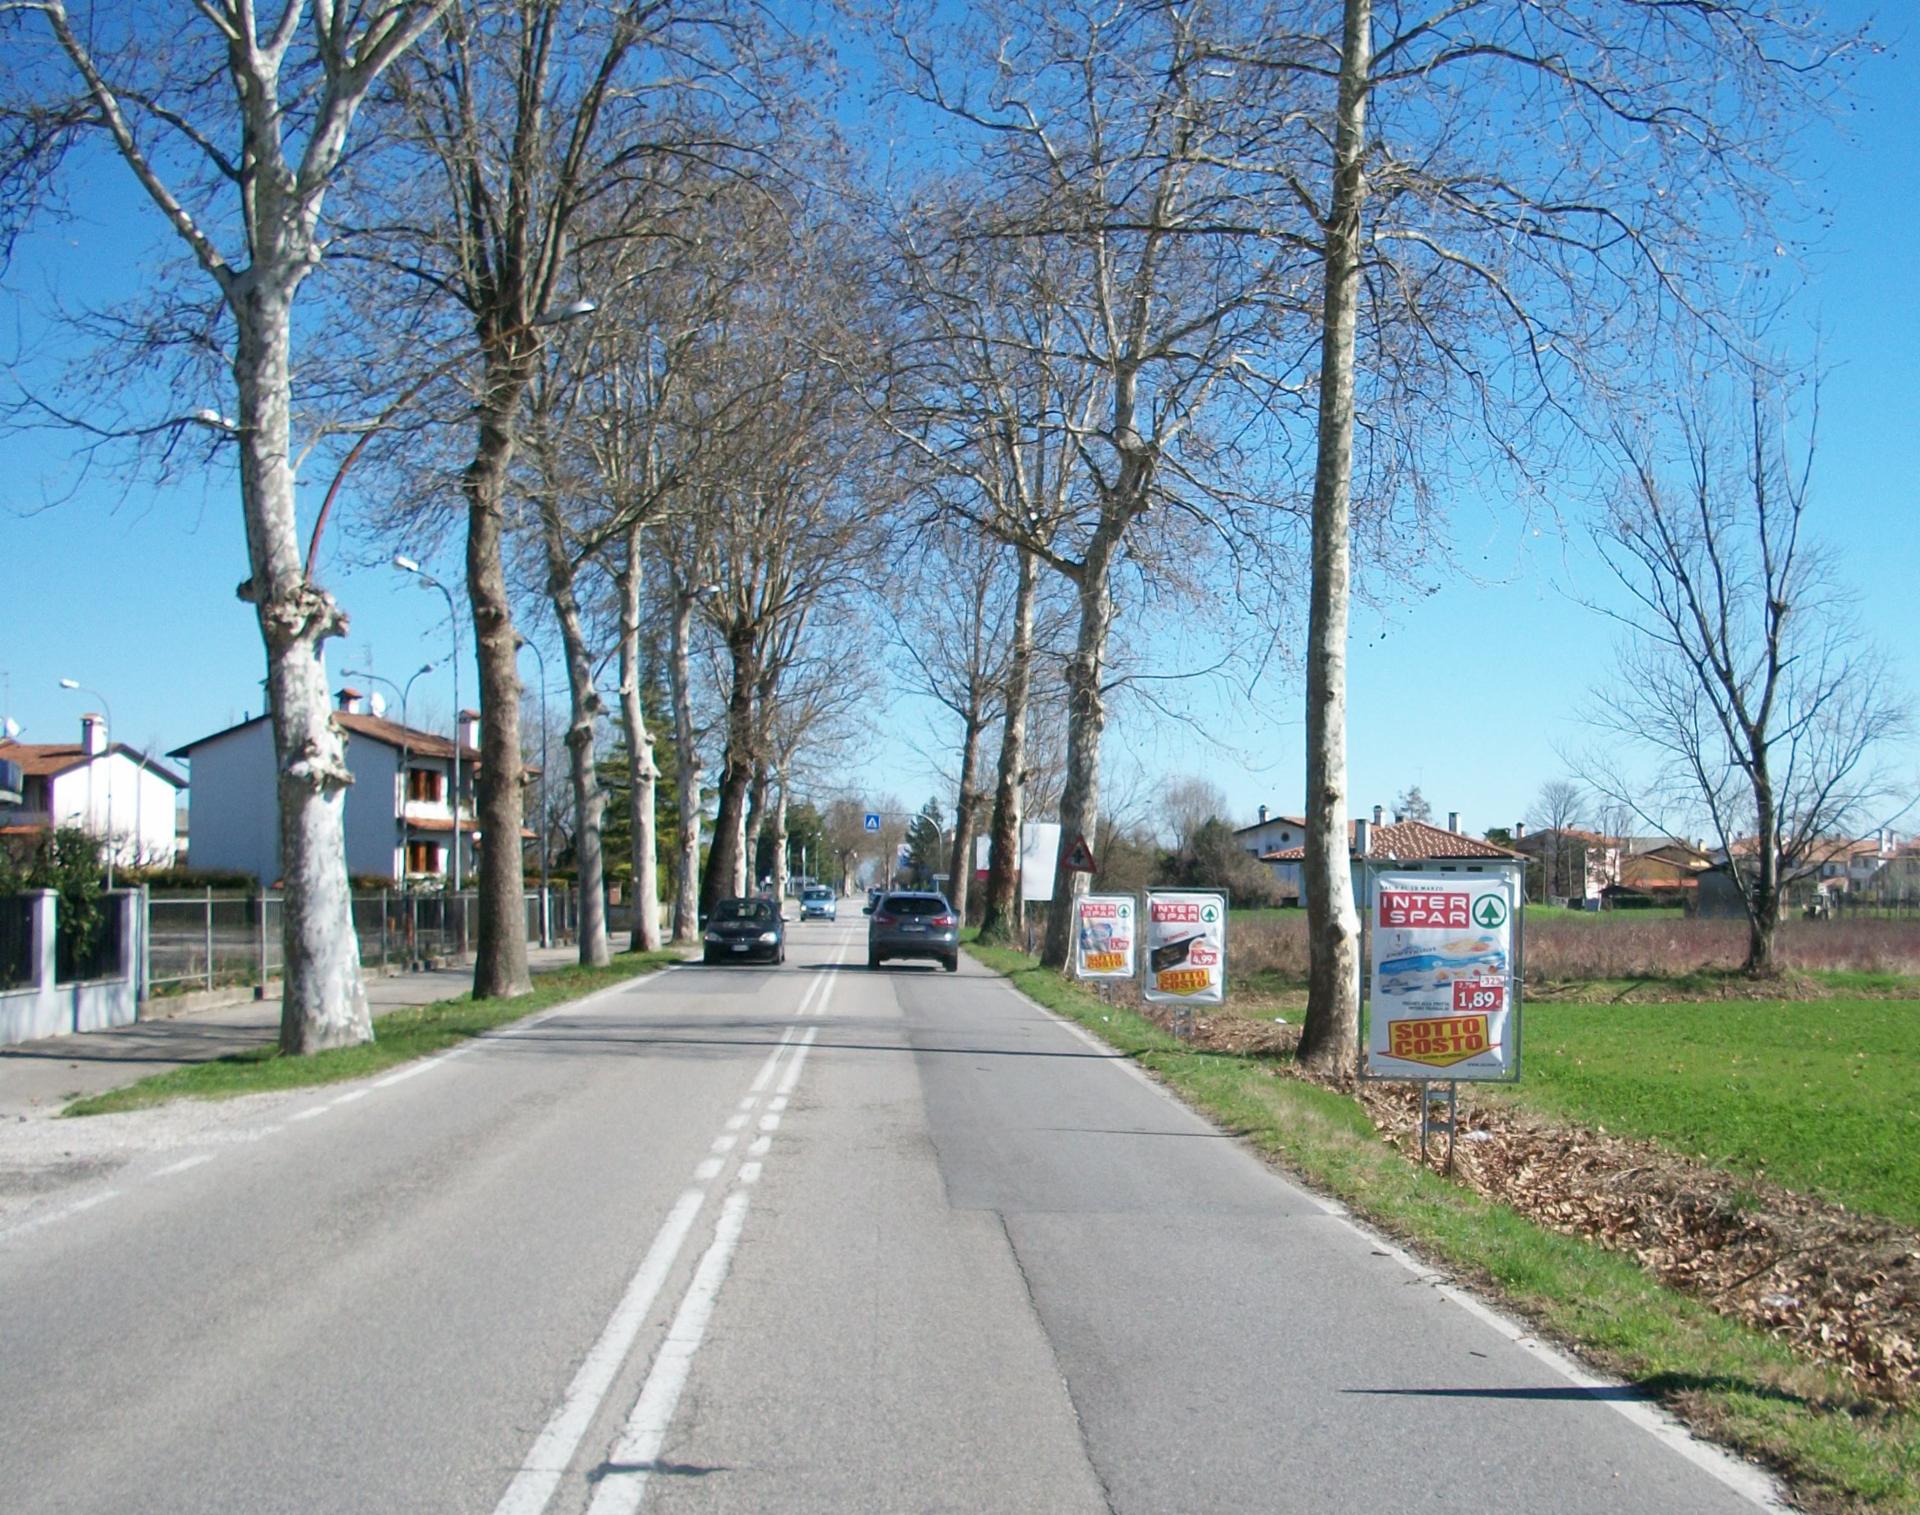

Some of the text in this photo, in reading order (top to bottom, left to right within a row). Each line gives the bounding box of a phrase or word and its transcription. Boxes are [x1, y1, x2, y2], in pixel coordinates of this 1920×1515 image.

[1153, 904, 1198, 913] INTER
[1382, 895, 1467, 909] INTER
[1157, 913, 1198, 921] SPAR
[1389, 911, 1467, 925] SPAR
[1159, 970, 1205, 982] SOTTO
[1159, 979, 1207, 991] COSTO
[1394, 1018, 1480, 1040] SOTTO
[1394, 1034, 1483, 1056] COSTO
